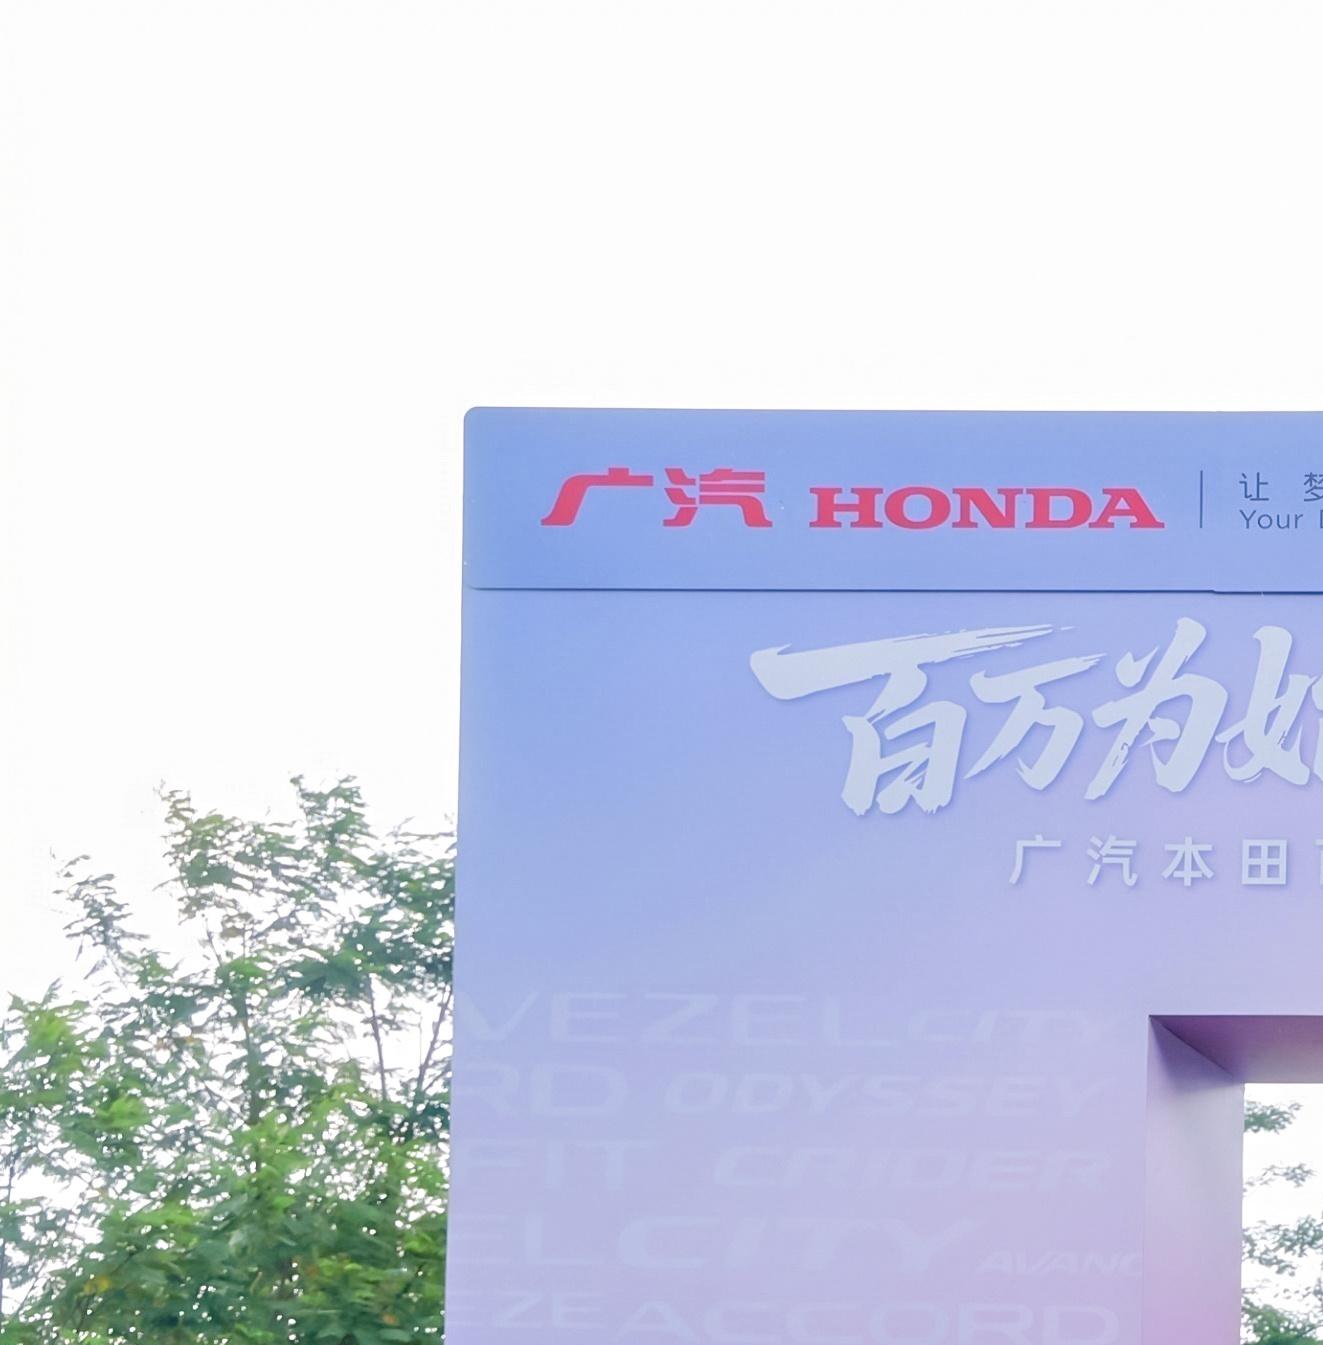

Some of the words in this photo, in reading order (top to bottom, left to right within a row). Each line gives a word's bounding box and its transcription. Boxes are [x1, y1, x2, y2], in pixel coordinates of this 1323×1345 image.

[540, 467, 773, 529] 广汽
[808, 486, 1166, 531] HONDA
[1238, 508, 1304, 530] Your
[664, 1070, 1115, 1118] ODYSSEY
[713, 1145, 1114, 1192] CRIDER
[616, 1213, 980, 1272] CITY
